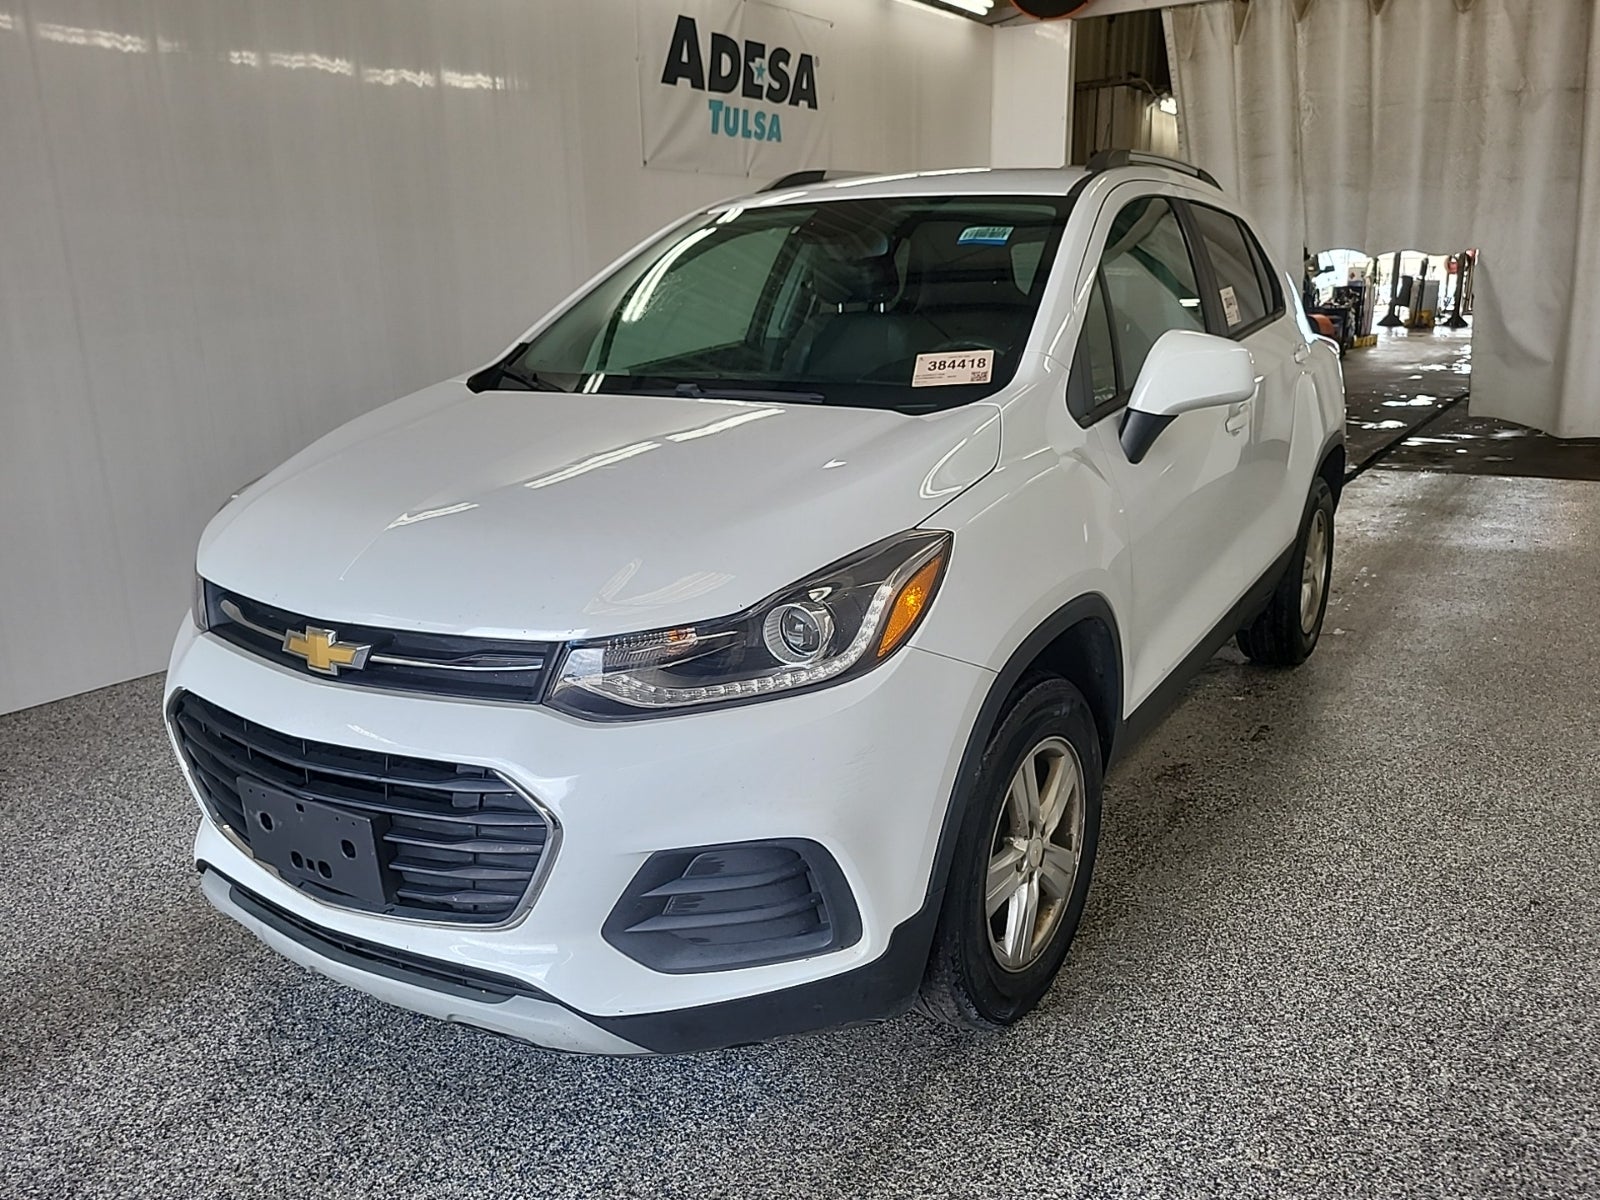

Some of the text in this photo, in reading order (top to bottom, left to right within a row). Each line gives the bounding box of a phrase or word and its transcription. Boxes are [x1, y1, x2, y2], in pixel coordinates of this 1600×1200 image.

[661, 14, 817, 110] ADESA
[708, 99, 782, 142] TULSA
[927, 358, 986, 371] 384418
